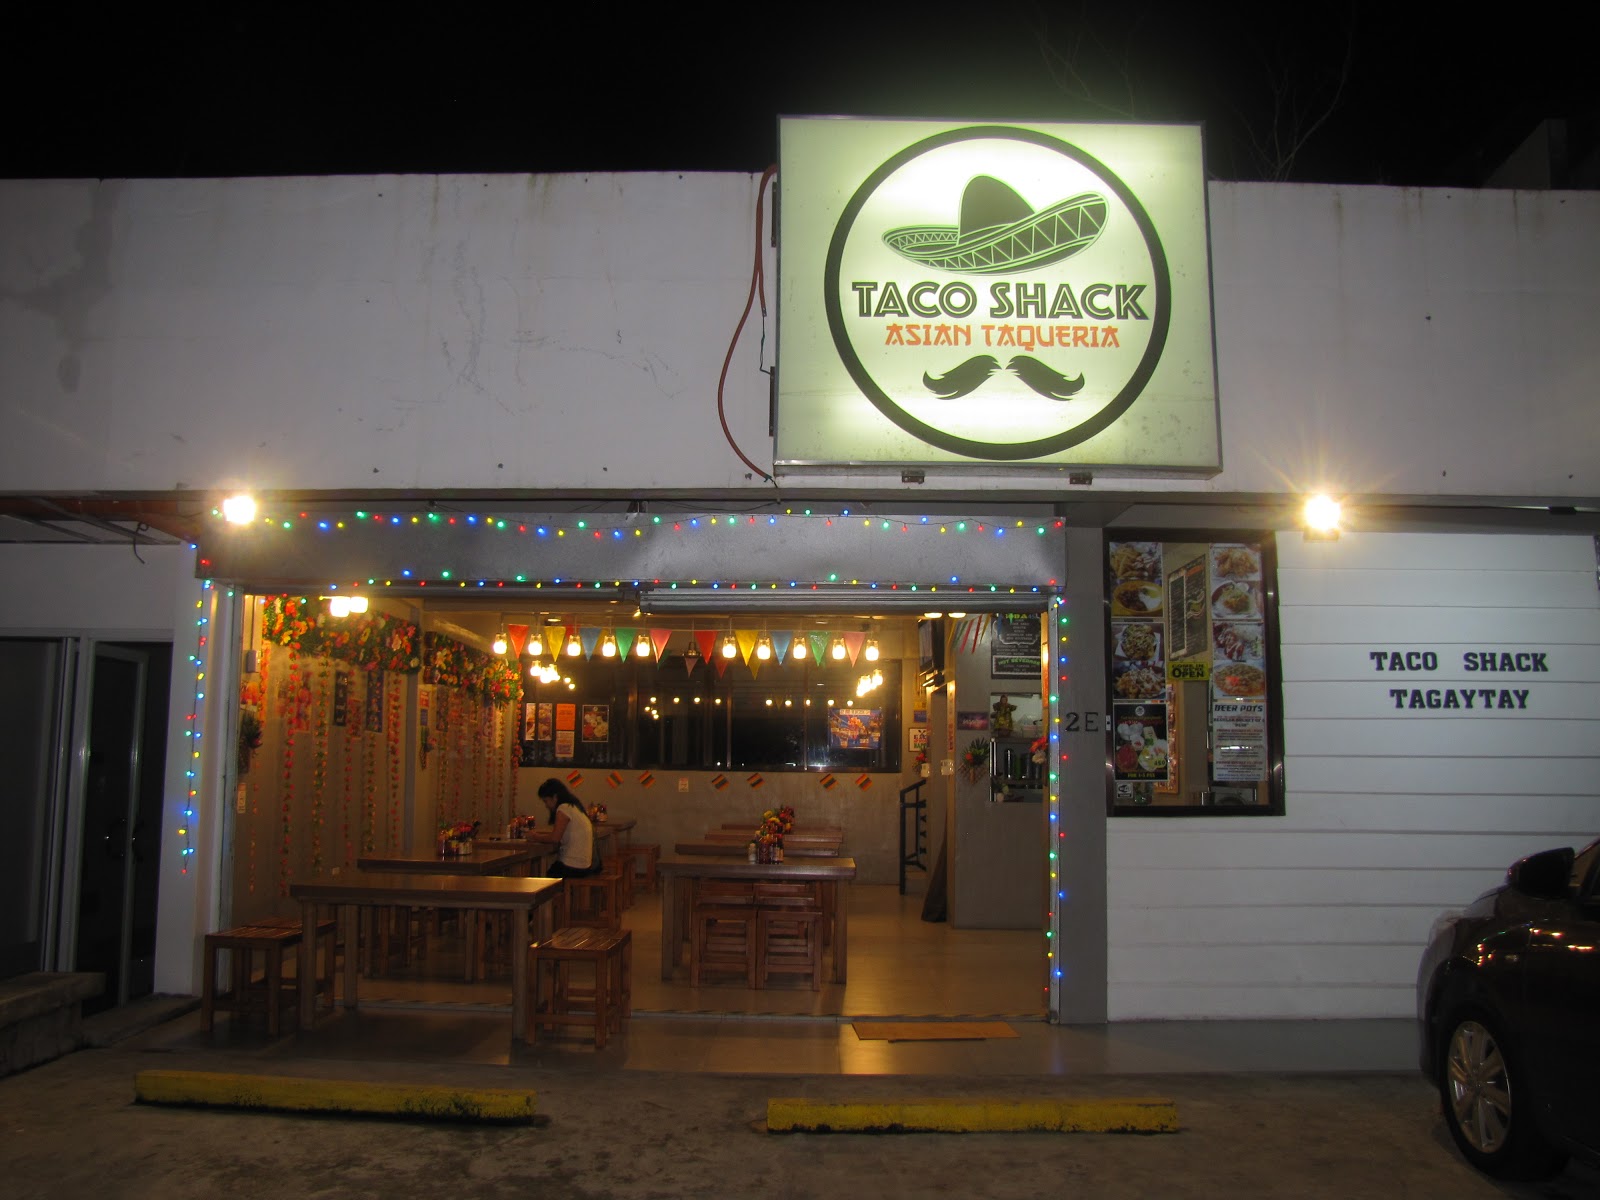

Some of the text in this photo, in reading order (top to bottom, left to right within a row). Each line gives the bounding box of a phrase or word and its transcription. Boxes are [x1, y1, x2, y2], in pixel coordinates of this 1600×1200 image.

[852, 281, 1149, 320] TACO SHACK
[885, 324, 1120, 352] ASIAN TAQUERIA
[1370, 651, 1549, 672] TACO SHACK
[1172, 667, 1204, 678] OPEN
[1389, 689, 1529, 709] TAGAYTAY
